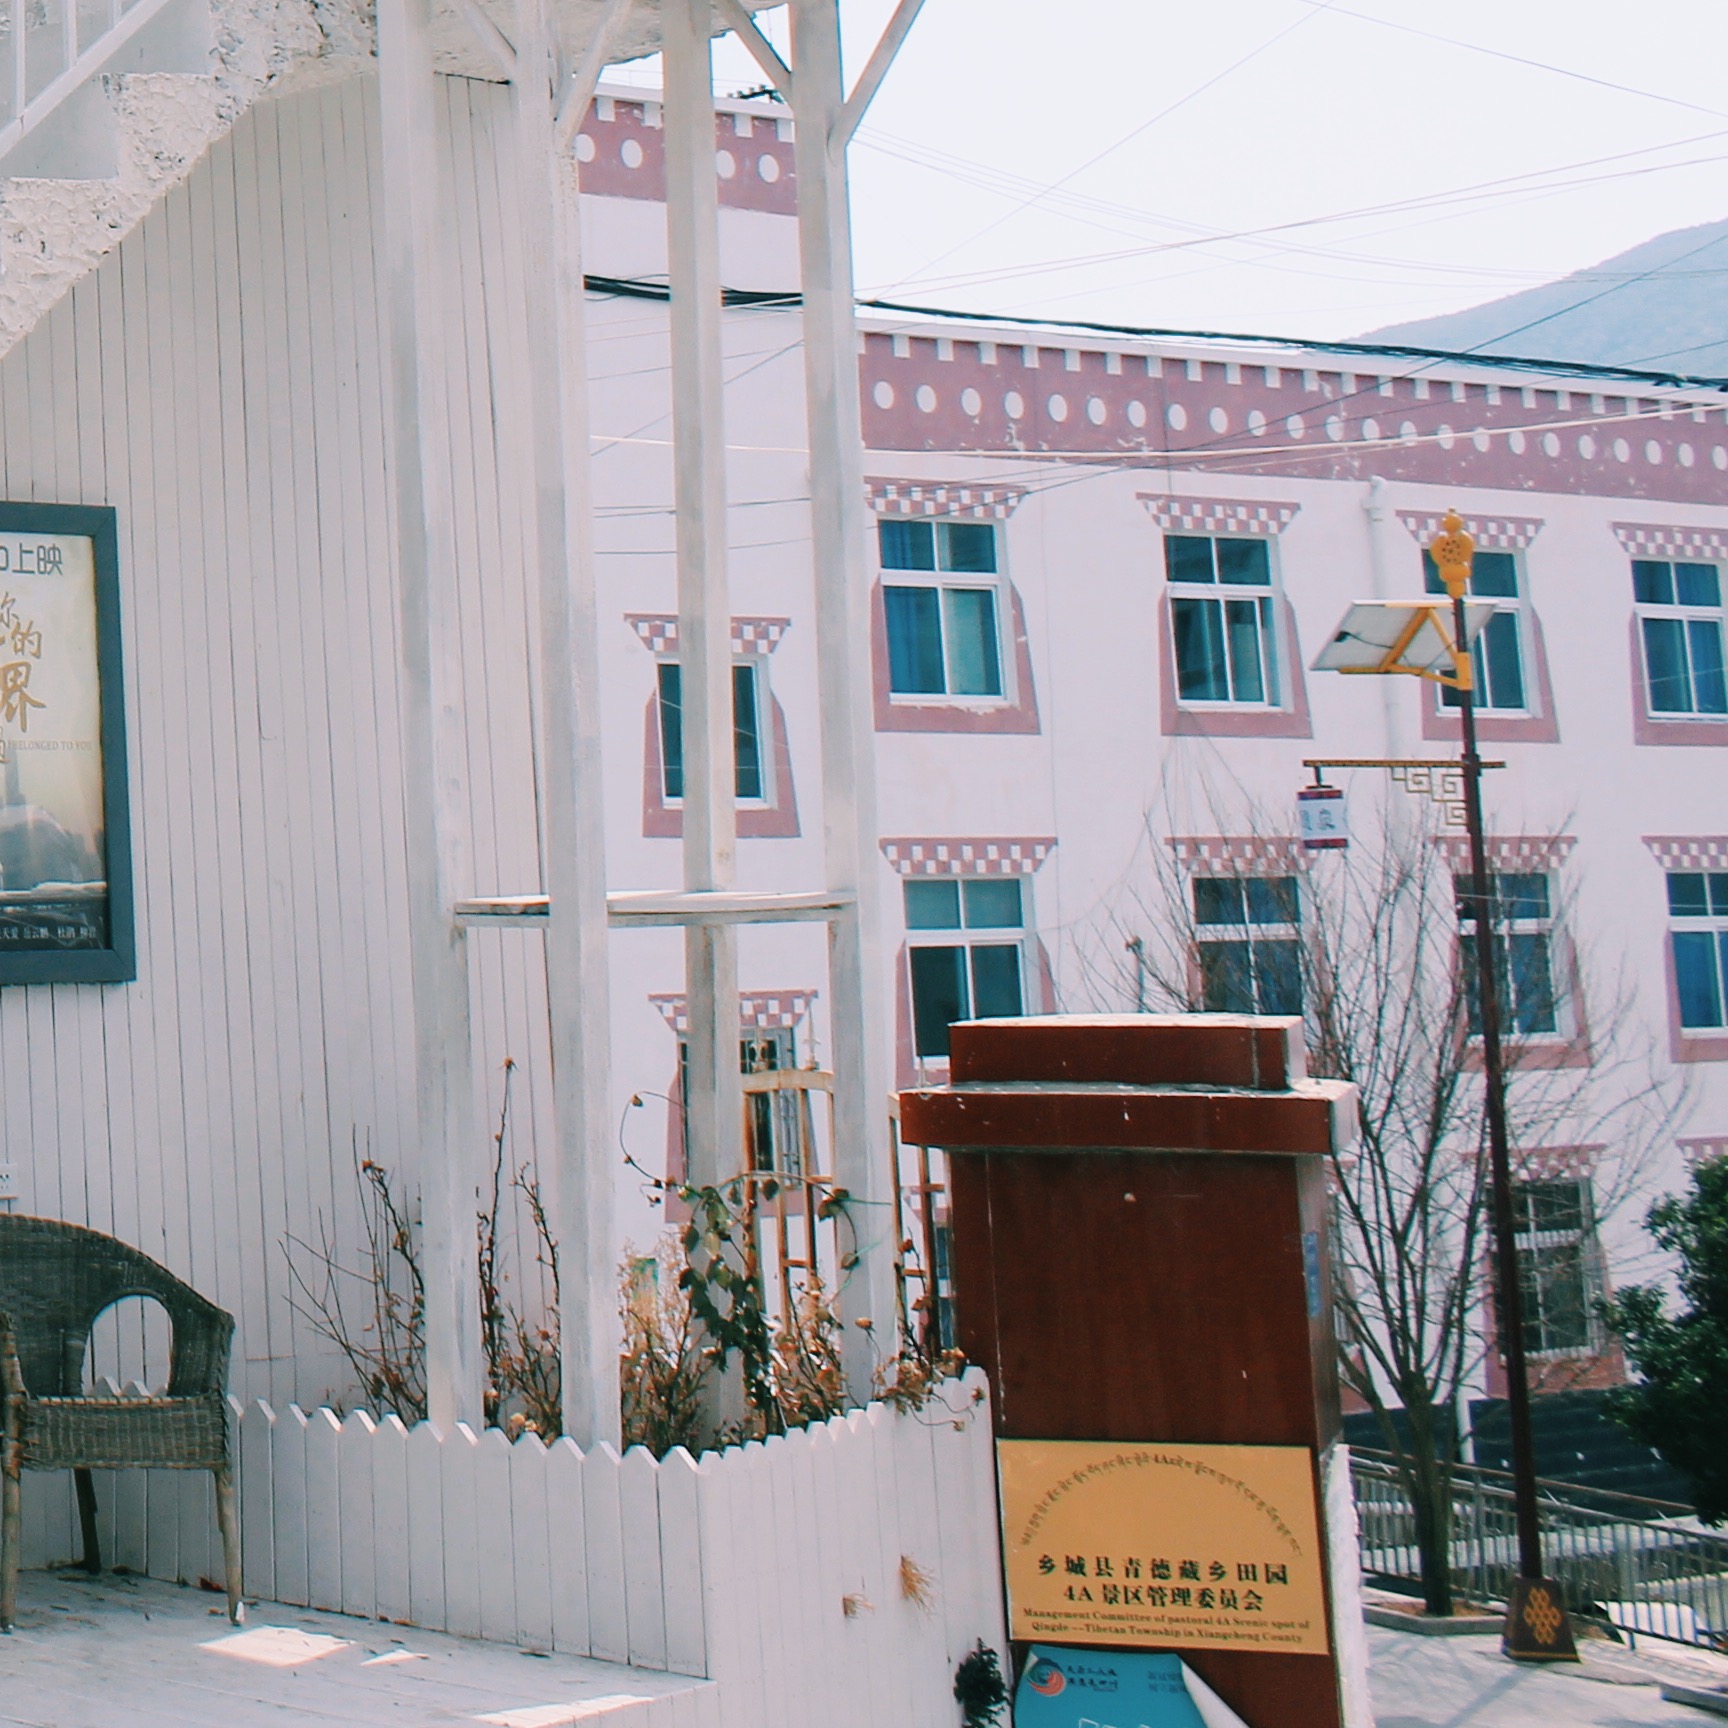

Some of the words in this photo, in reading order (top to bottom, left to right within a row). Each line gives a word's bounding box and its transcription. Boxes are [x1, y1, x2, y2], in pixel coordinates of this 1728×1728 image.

[1038, 1553, 1288, 1585] 乡城县青德藏乡田园
[1063, 1584, 1094, 1603] 4A
[1102, 1583, 1264, 1612] 景区管理委员会
[1023, 1607, 1090, 1620] Management
[1093, 1611, 1151, 1623] Committee
[1154, 1612, 1166, 1622] of
[1167, 1615, 1213, 1626] pastoral
[1233, 1618, 1269, 1628] Scenic
[1271, 1620, 1296, 1631] spot
[1298, 1620, 1311, 1630] of
[1032, 1621, 1069, 1633] Qingde
[1127, 1625, 1181, 1639] Township
[1184, 1630, 1195, 1638] in
[1196, 1628, 1260, 1643] Xiangcheng
[1263, 1632, 1303, 1644] County
